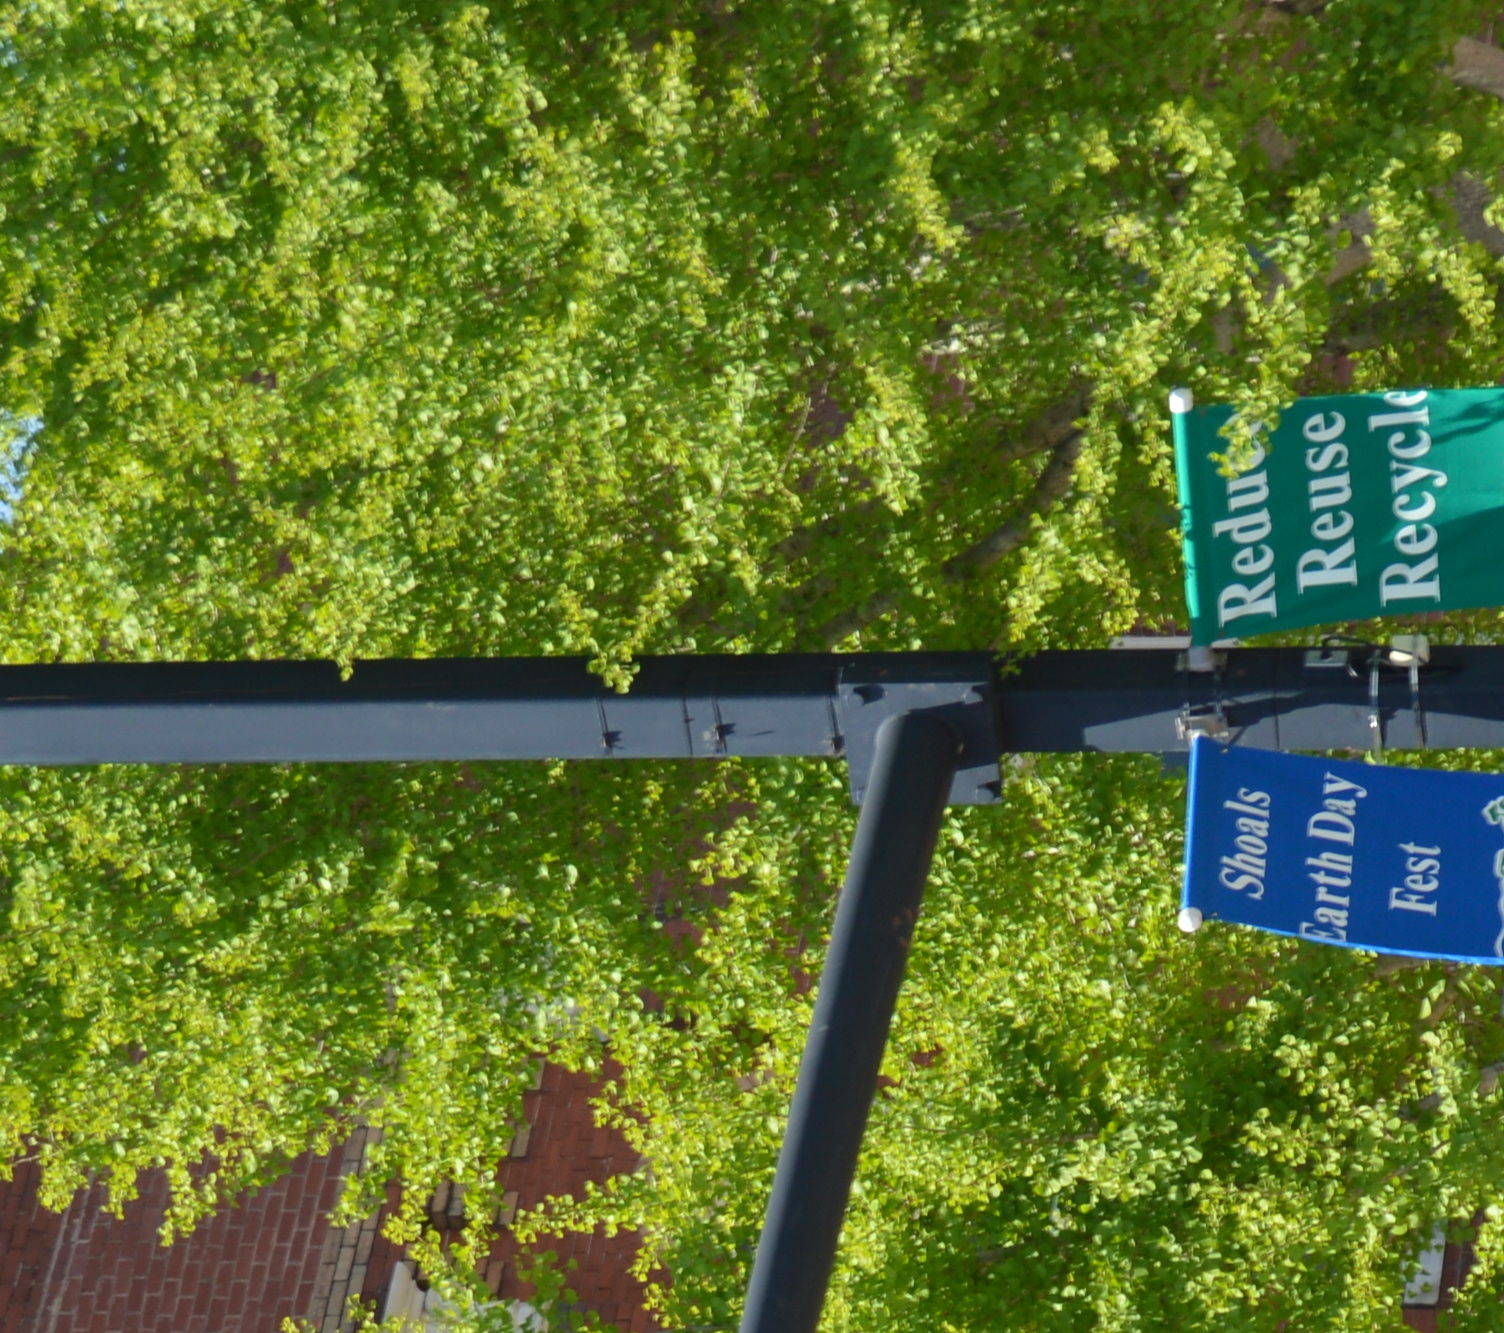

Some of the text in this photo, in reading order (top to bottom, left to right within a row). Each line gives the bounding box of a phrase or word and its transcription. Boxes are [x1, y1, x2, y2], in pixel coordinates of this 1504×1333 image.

[1296, 411, 1358, 594] Reuse
[1367, 390, 1448, 607] Recycle
[1219, 787, 1271, 899] Shoals
[1299, 770, 1368, 943] Earth Day
[1388, 841, 1442, 916] Fest
